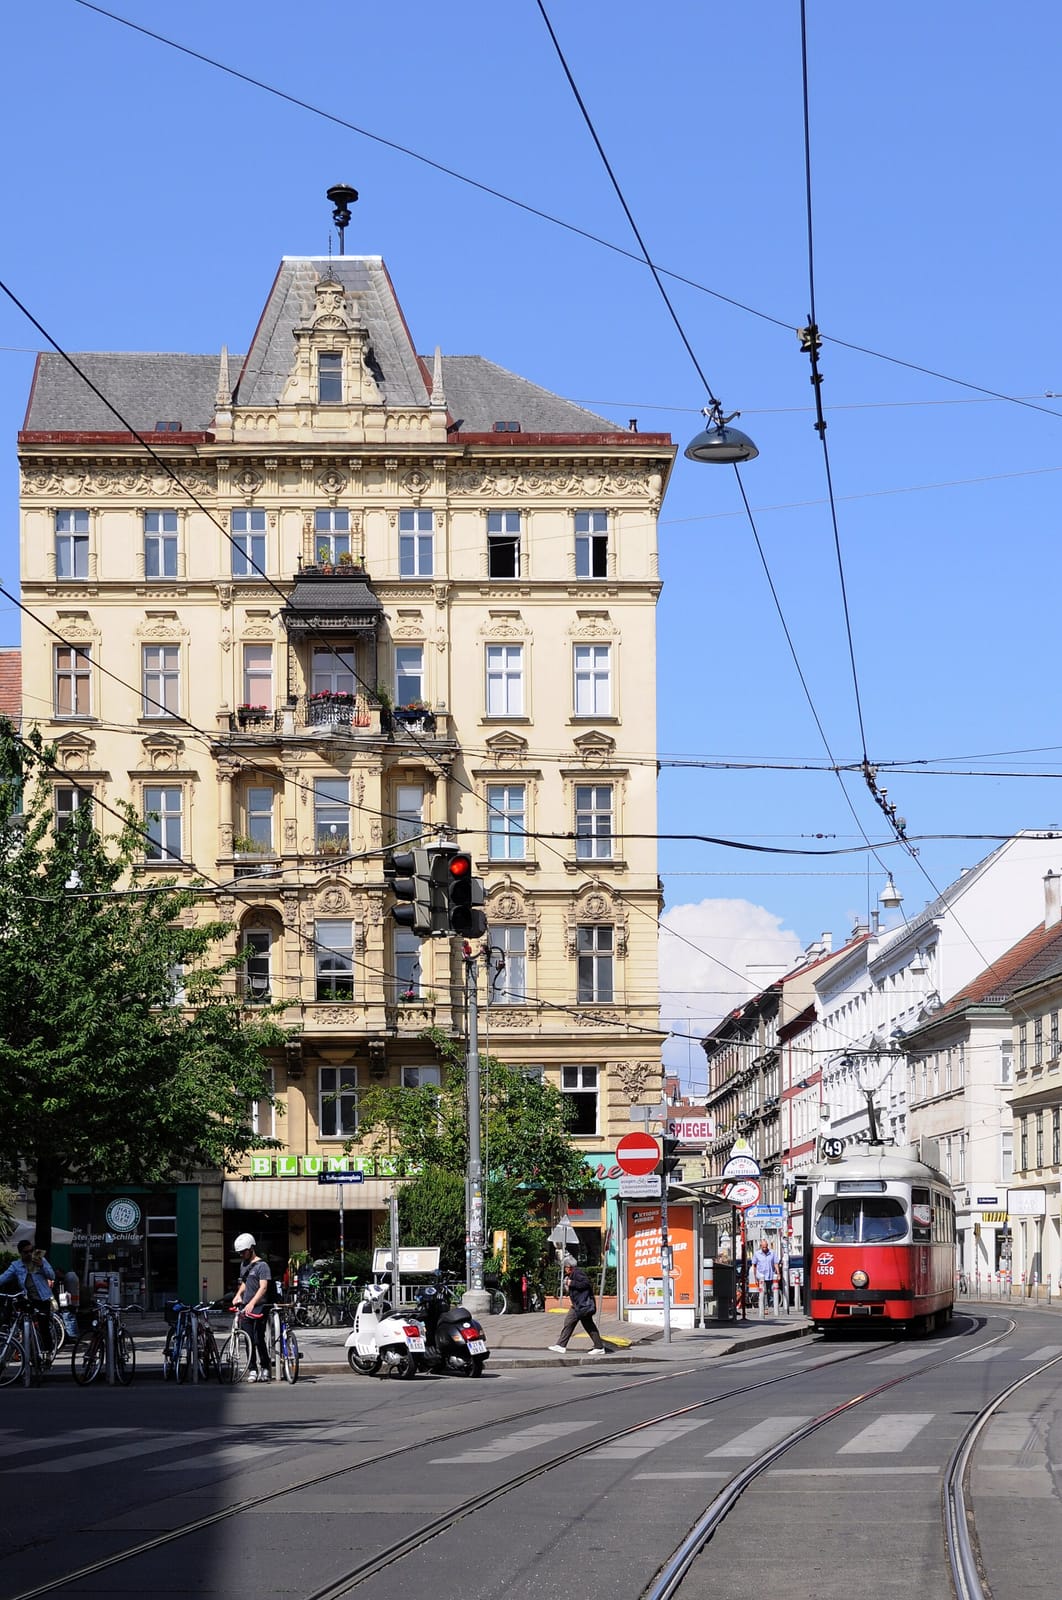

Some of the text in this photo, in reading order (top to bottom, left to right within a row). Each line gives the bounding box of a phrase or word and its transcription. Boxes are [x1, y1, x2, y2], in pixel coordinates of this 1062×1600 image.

[669, 1122, 713, 1138] SPIEGEL
[824, 1141, 843, 1156] 49
[112, 1232, 144, 1241] Schilder
[634, 1228, 657, 1238] BIER
[634, 1247, 655, 1257] HAT
[816, 1265, 834, 1275] 4558
